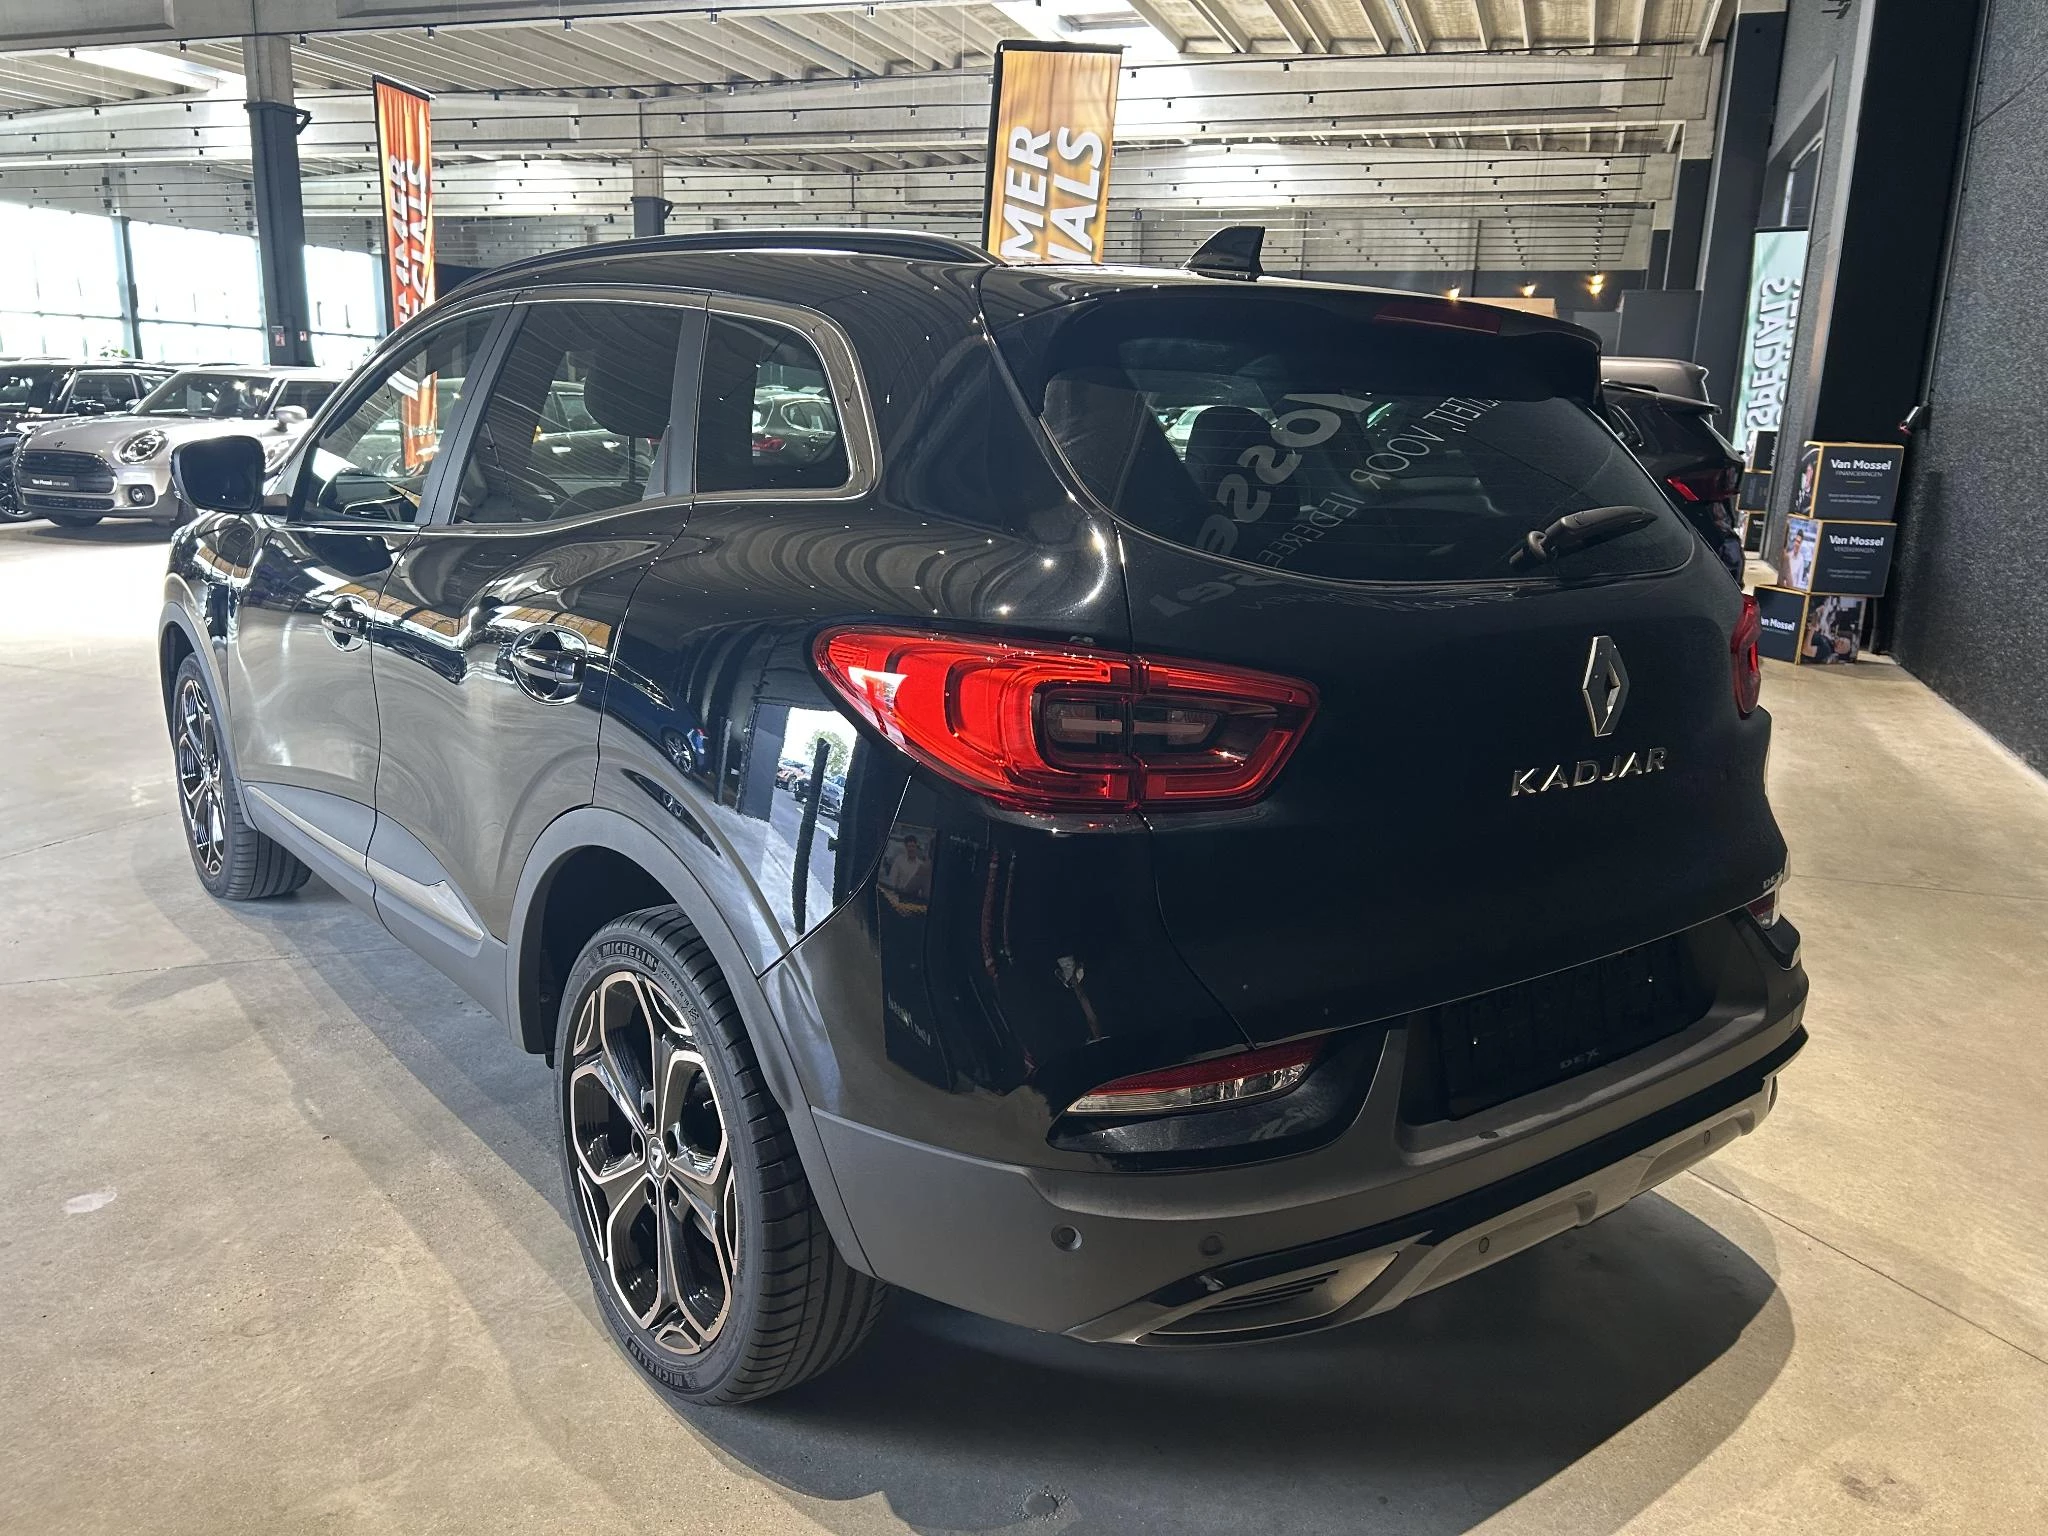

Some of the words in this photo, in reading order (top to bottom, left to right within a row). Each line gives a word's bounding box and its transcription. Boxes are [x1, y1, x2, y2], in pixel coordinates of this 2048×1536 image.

[1830, 459, 1851, 469] Van
[1853, 460, 1893, 471] Mossel
[1829, 534, 1848, 545] Van
[1849, 536, 1885, 547] Mossel
[1770, 617, 1796, 632] Mossel
[1510, 747, 1668, 797] KADJAR
[602, 942, 656, 968] MICHELIN
[628, 1341, 684, 1388] MICHELIN
